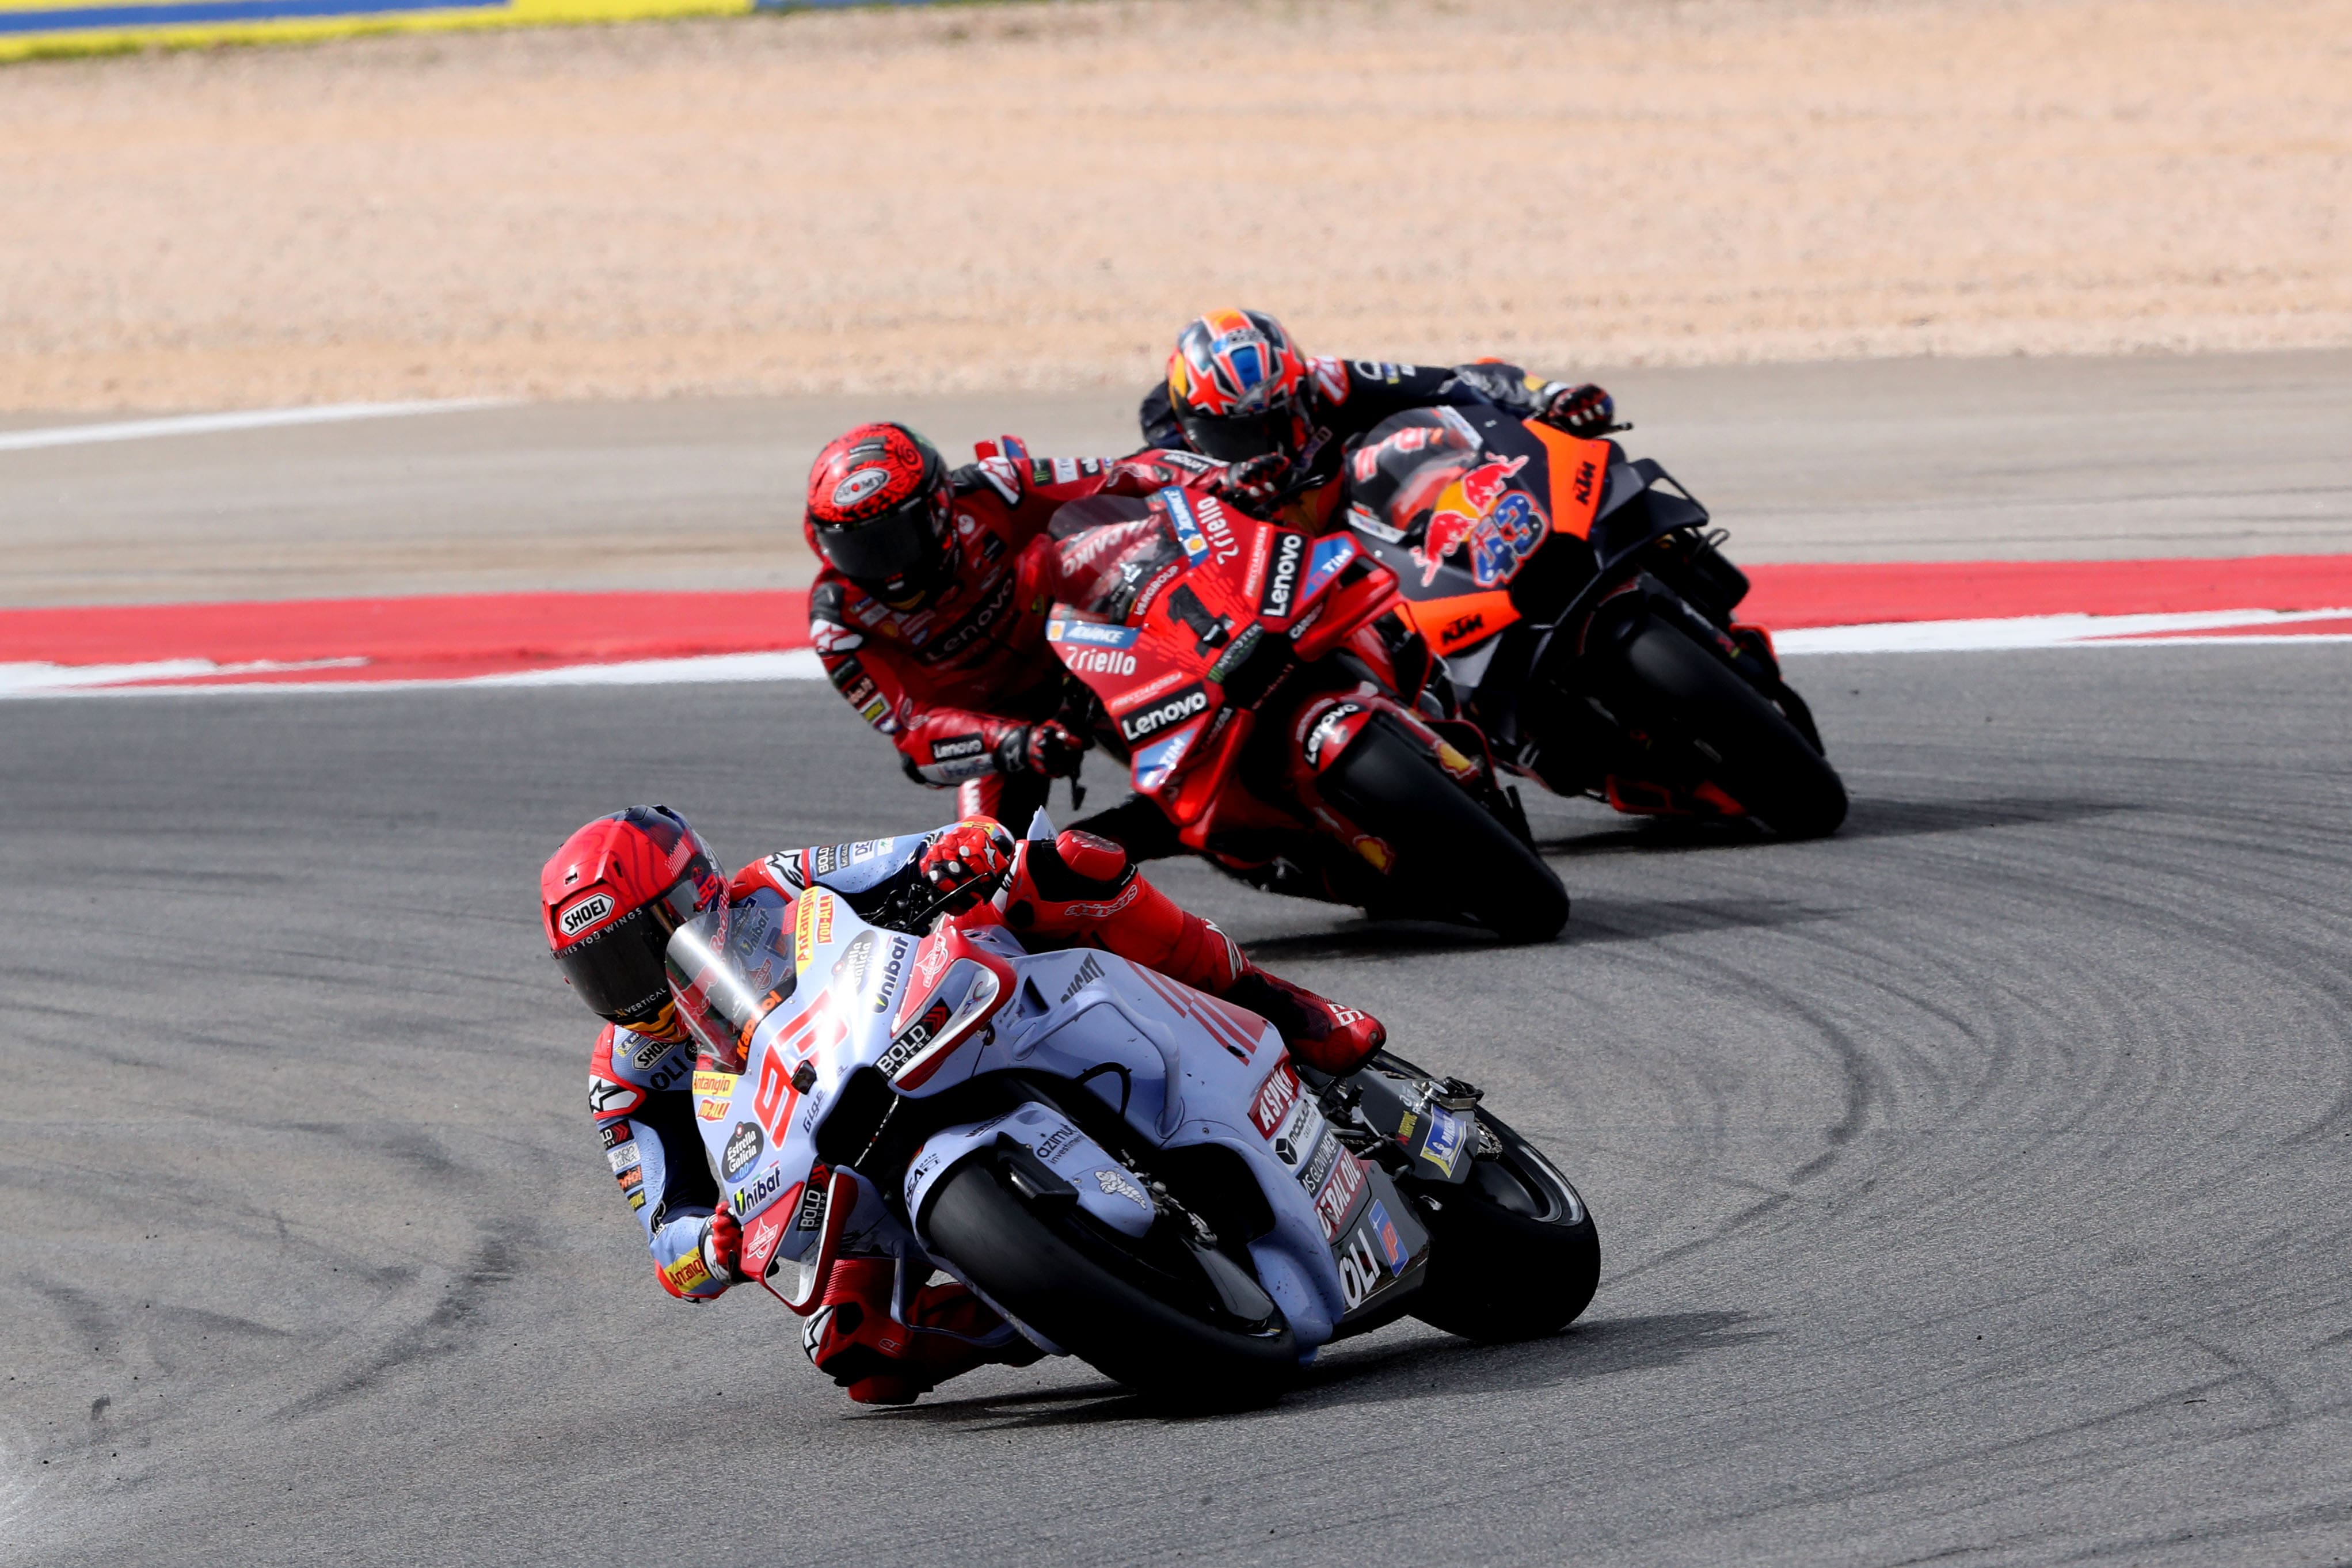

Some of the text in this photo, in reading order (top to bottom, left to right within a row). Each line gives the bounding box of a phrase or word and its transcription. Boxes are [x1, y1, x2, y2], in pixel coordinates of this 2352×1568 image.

[1575, 461, 1596, 505] KTM
[1263, 534, 1301, 616] Lenovo
[1322, 549, 1352, 572] TIM
[926, 577, 1013, 661] Lenovo
[1442, 613, 1484, 645] KTM
[1122, 692, 1207, 741] Lenovo
[1304, 704, 1359, 764] Lenovo
[933, 739, 982, 759] Lenovo
[818, 847, 830, 874] BOLD
[855, 840, 870, 857] DE
[557, 907, 643, 959] GIVES YOU WINGS
[565, 898, 606, 931] SHOEI
[797, 890, 814, 961] Antangin
[819, 895, 833, 943] YOU-ALL
[872, 936, 909, 1014] Unibat
[625, 988, 667, 1014] VERTICAL
[737, 991, 783, 1060] Kapol
[637, 1043, 670, 1067] SHO
[876, 1025, 926, 1073] BOLD
[886, 1034, 931, 1077] RIDERS
[694, 1074, 730, 1095] Antangin
[727, 1130, 756, 1161] Estrella
[729, 1145, 757, 1173] Galicia
[1037, 1123, 1075, 1159] azimut
[734, 1166, 781, 1217] Unibat
[1341, 1151, 1361, 1193] OIL
[800, 1190, 821, 1227] BOLD
[815, 1193, 827, 1227] RIDERS
[669, 1253, 707, 1287] Antangi
[1339, 1227, 1380, 1309] OLI
